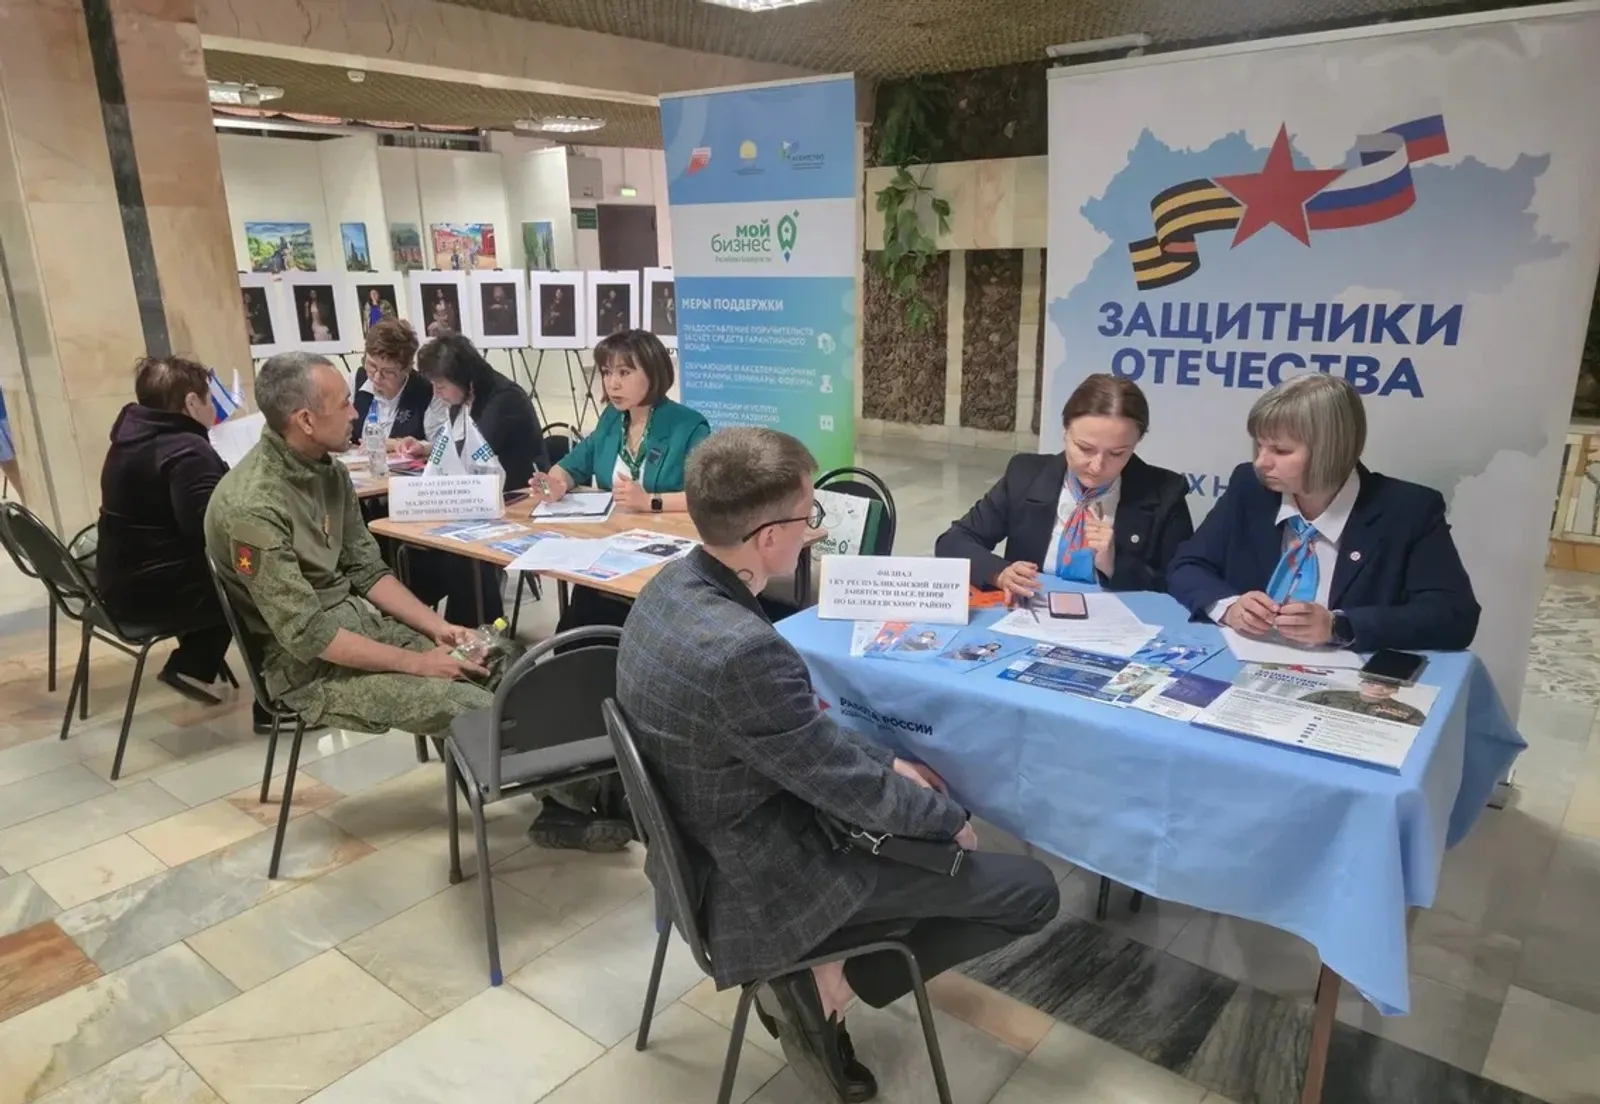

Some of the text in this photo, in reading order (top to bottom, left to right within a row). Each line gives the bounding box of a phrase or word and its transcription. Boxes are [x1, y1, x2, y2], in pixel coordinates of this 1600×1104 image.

[711, 233, 771, 252] бизнес
[682, 298, 784, 312] МЕРЫ ПОДДЕРЖКИ
[1098, 301, 1463, 346] ЗАЩИТНИКИ
[877, 569, 912, 577] ФИЛИАЛ
[847, 579, 929, 589] РЕСПУБЛИКАНСКИЙ
[932, 582, 961, 590] ЦЕНТР
[844, 588, 945, 598] ЗАНЯТОСТИ НАСЕЛЕНИЯ
[919, 600, 952, 610] РАЙОНУ
[881, 715, 933, 735] РОССИИ
